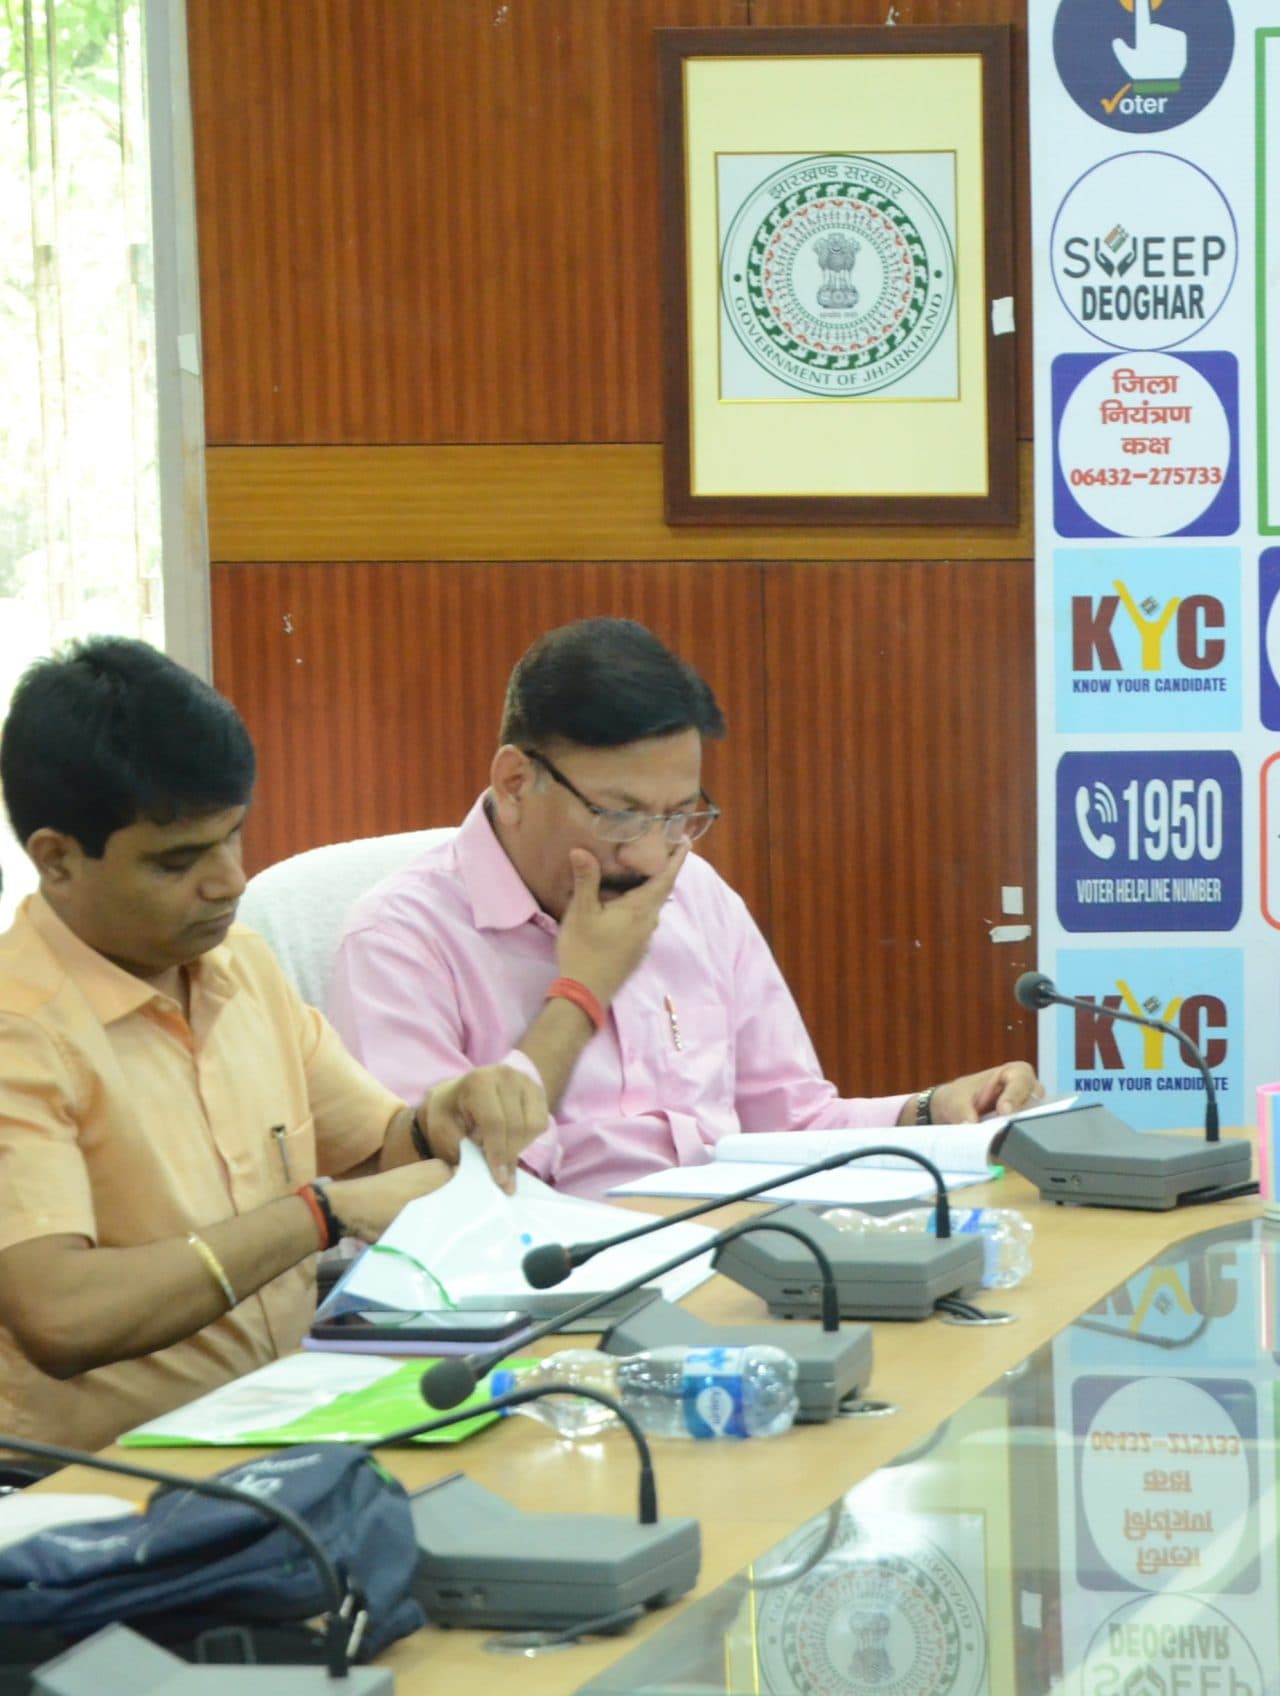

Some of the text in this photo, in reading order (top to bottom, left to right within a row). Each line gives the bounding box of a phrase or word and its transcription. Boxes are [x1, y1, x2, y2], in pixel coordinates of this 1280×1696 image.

[845, 165, 904, 199] सरकार
[1081, 285, 1205, 321] DEOGHAR
[736, 293, 943, 387] GOVERNMENT OF JHARKHAND
[1112, 368, 1179, 394] जिला
[1099, 399, 1192, 424] नियंत्रण
[1121, 437, 1171, 455] कक्ष
[1070, 467, 1222, 487] 06432-275733
[1072, 580, 1225, 671] KYC
[1073, 678, 1226, 693] KNOW YOUR CANDIDATE
[1123, 779, 1222, 860] 1950
[1077, 878, 1221, 903] VOTER HELPLINE NUMBER
[1074, 979, 1228, 1070] KYC
[1075, 1076, 1230, 1092] KNOW YOUR CANDIDTE
